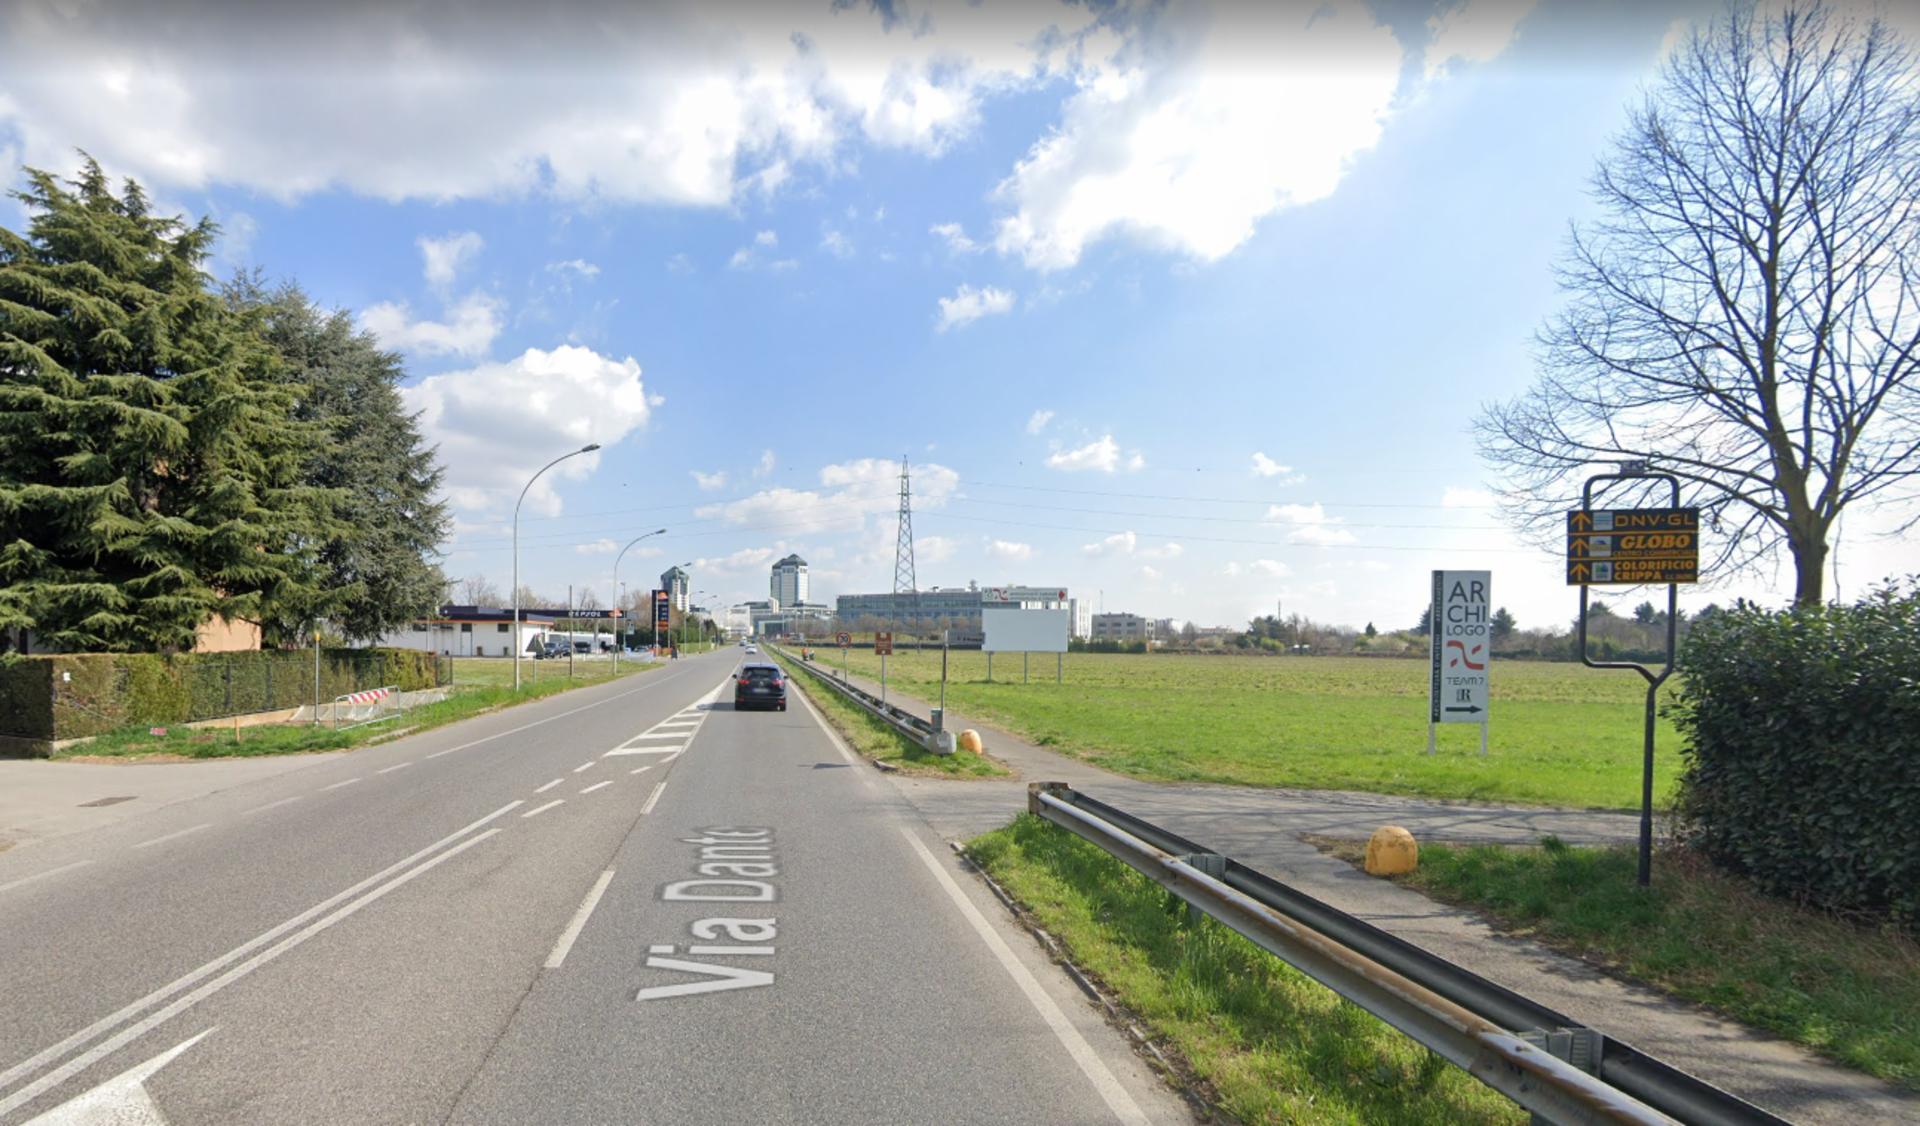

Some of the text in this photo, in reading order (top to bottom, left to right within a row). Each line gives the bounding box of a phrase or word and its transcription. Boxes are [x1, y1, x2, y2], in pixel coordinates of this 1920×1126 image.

[1620, 535, 1690, 549] GLOBO
[1615, 560, 1694, 570] COLORIFICIO
[1614, 571, 1661, 580] CRIPPA
[1448, 580, 1485, 603] AR
[1447, 605, 1486, 623] CHI
[1446, 624, 1486, 636] LOGO
